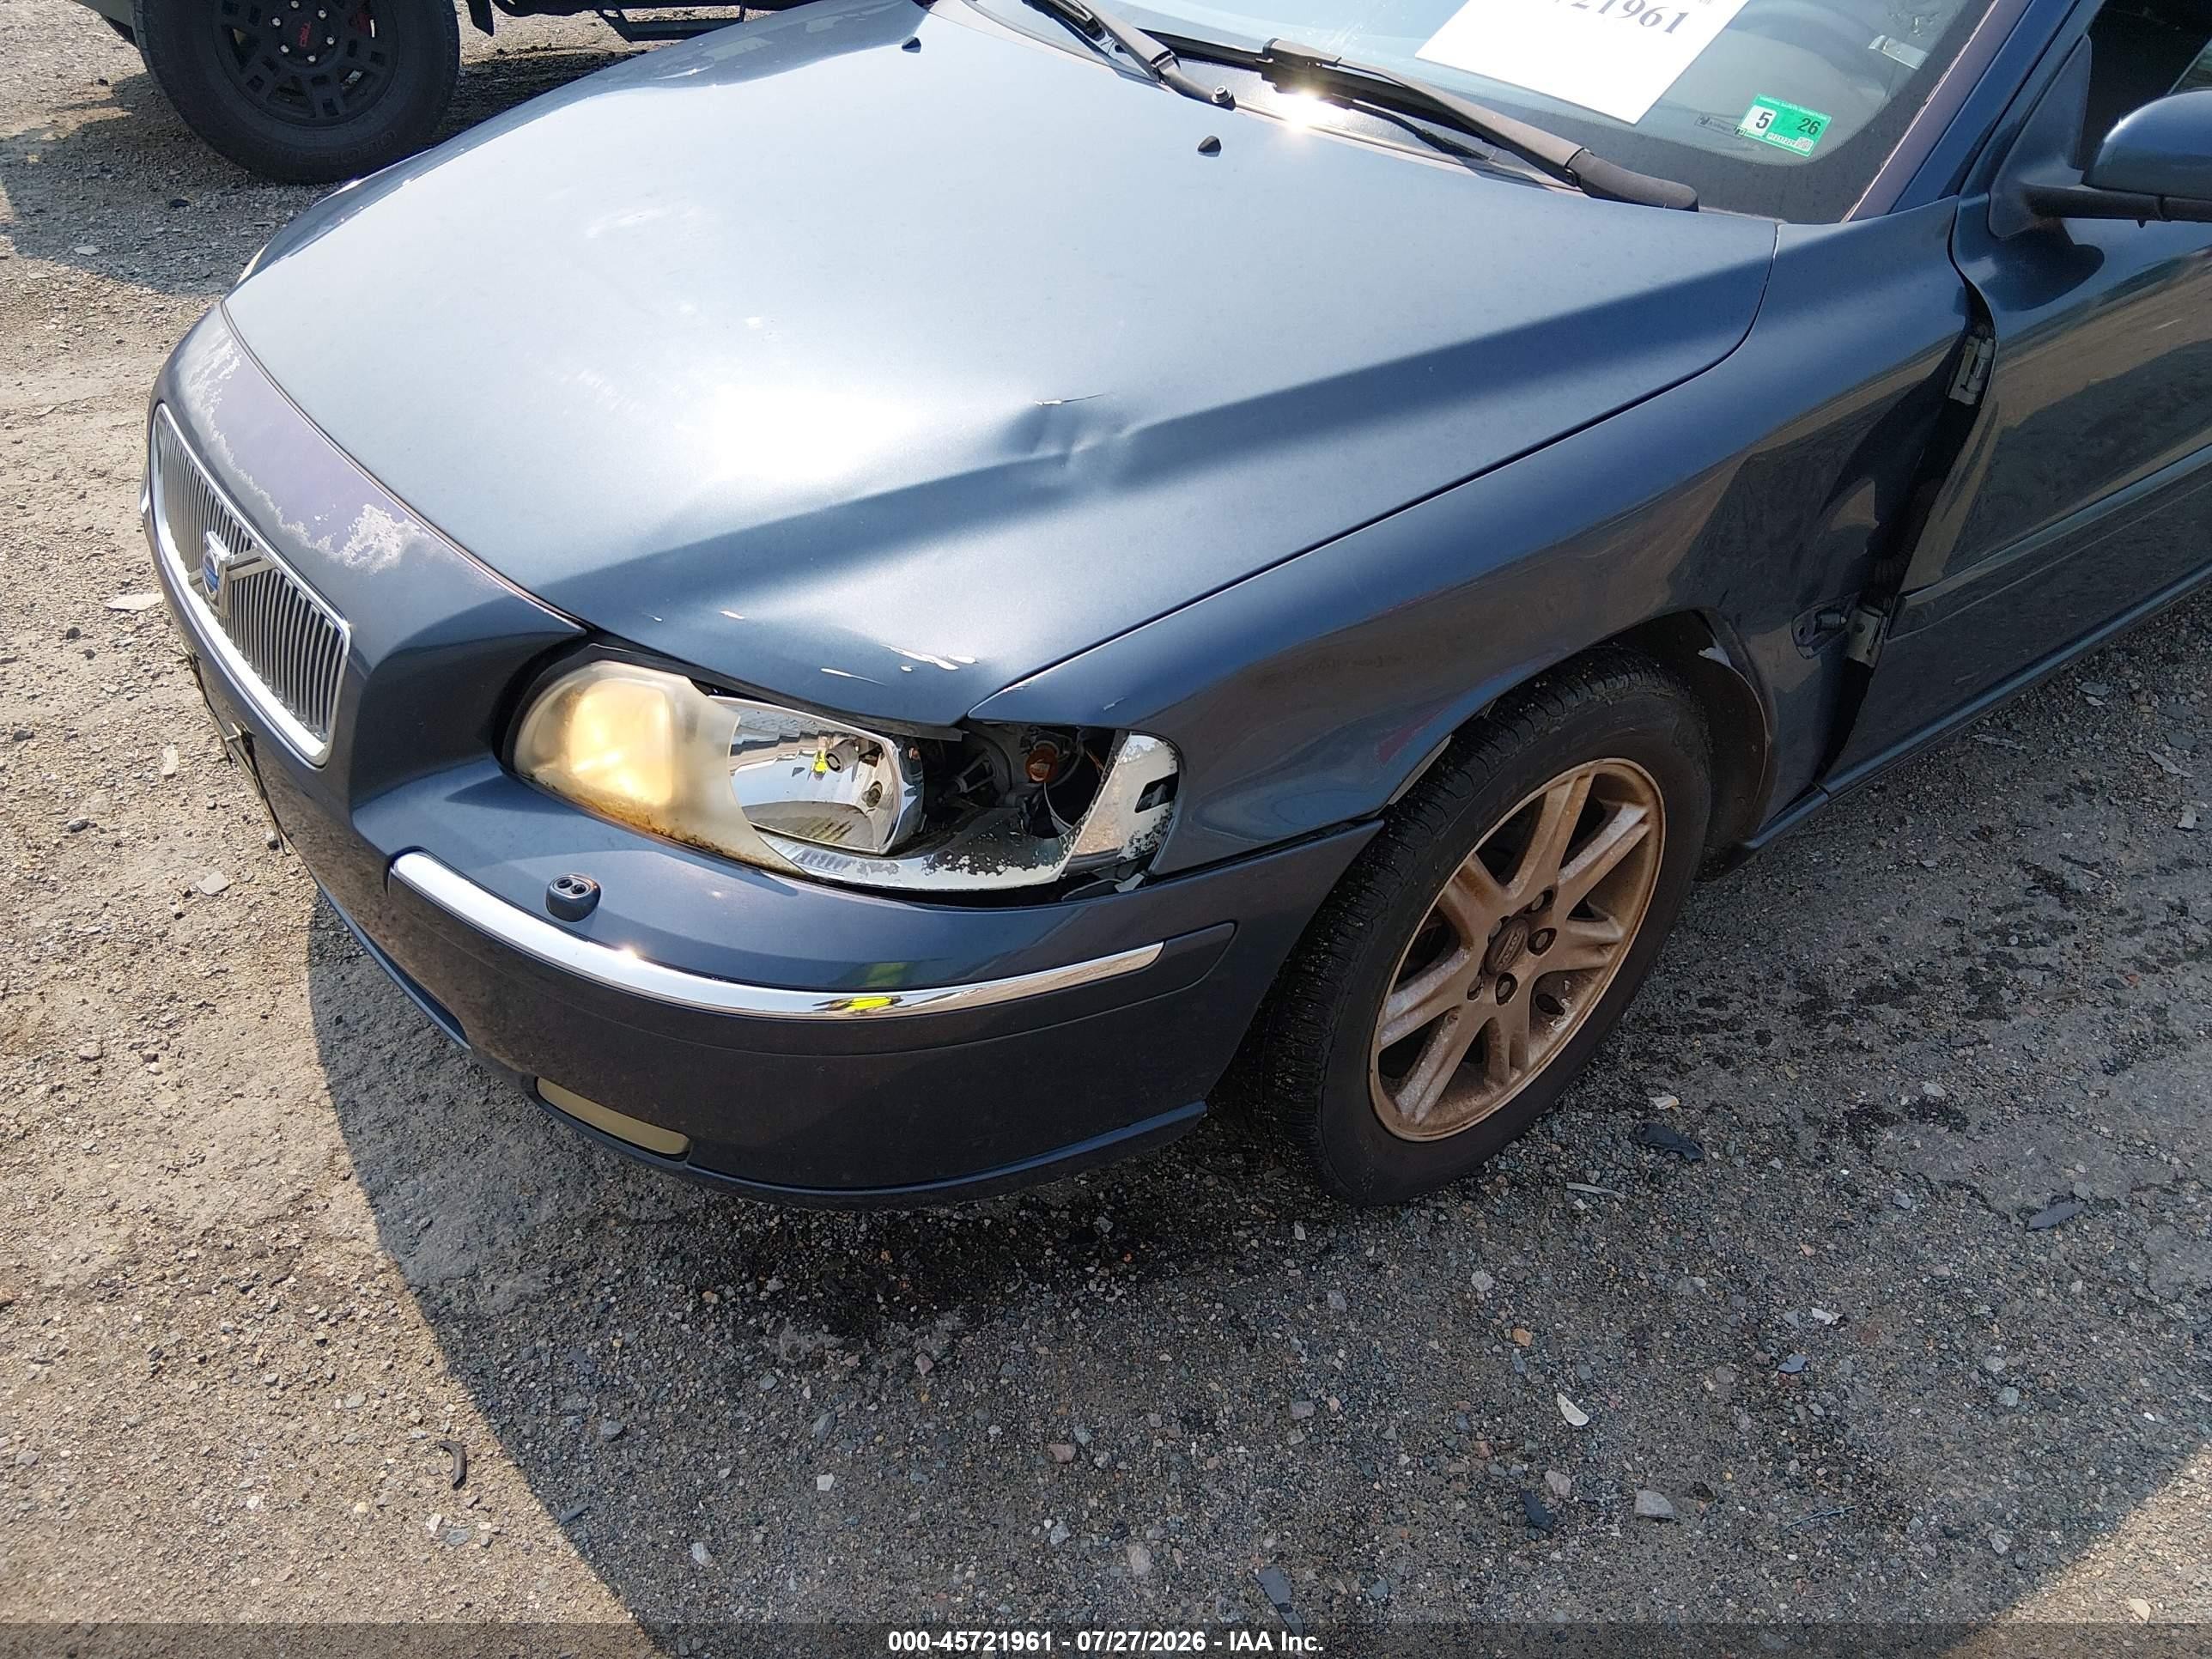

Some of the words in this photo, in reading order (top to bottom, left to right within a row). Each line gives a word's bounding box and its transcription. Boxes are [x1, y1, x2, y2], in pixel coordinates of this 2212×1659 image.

[1556, 0, 1690, 33] 1961
[1755, 112, 1773, 129] 5
[1796, 118, 1821, 136] 26
